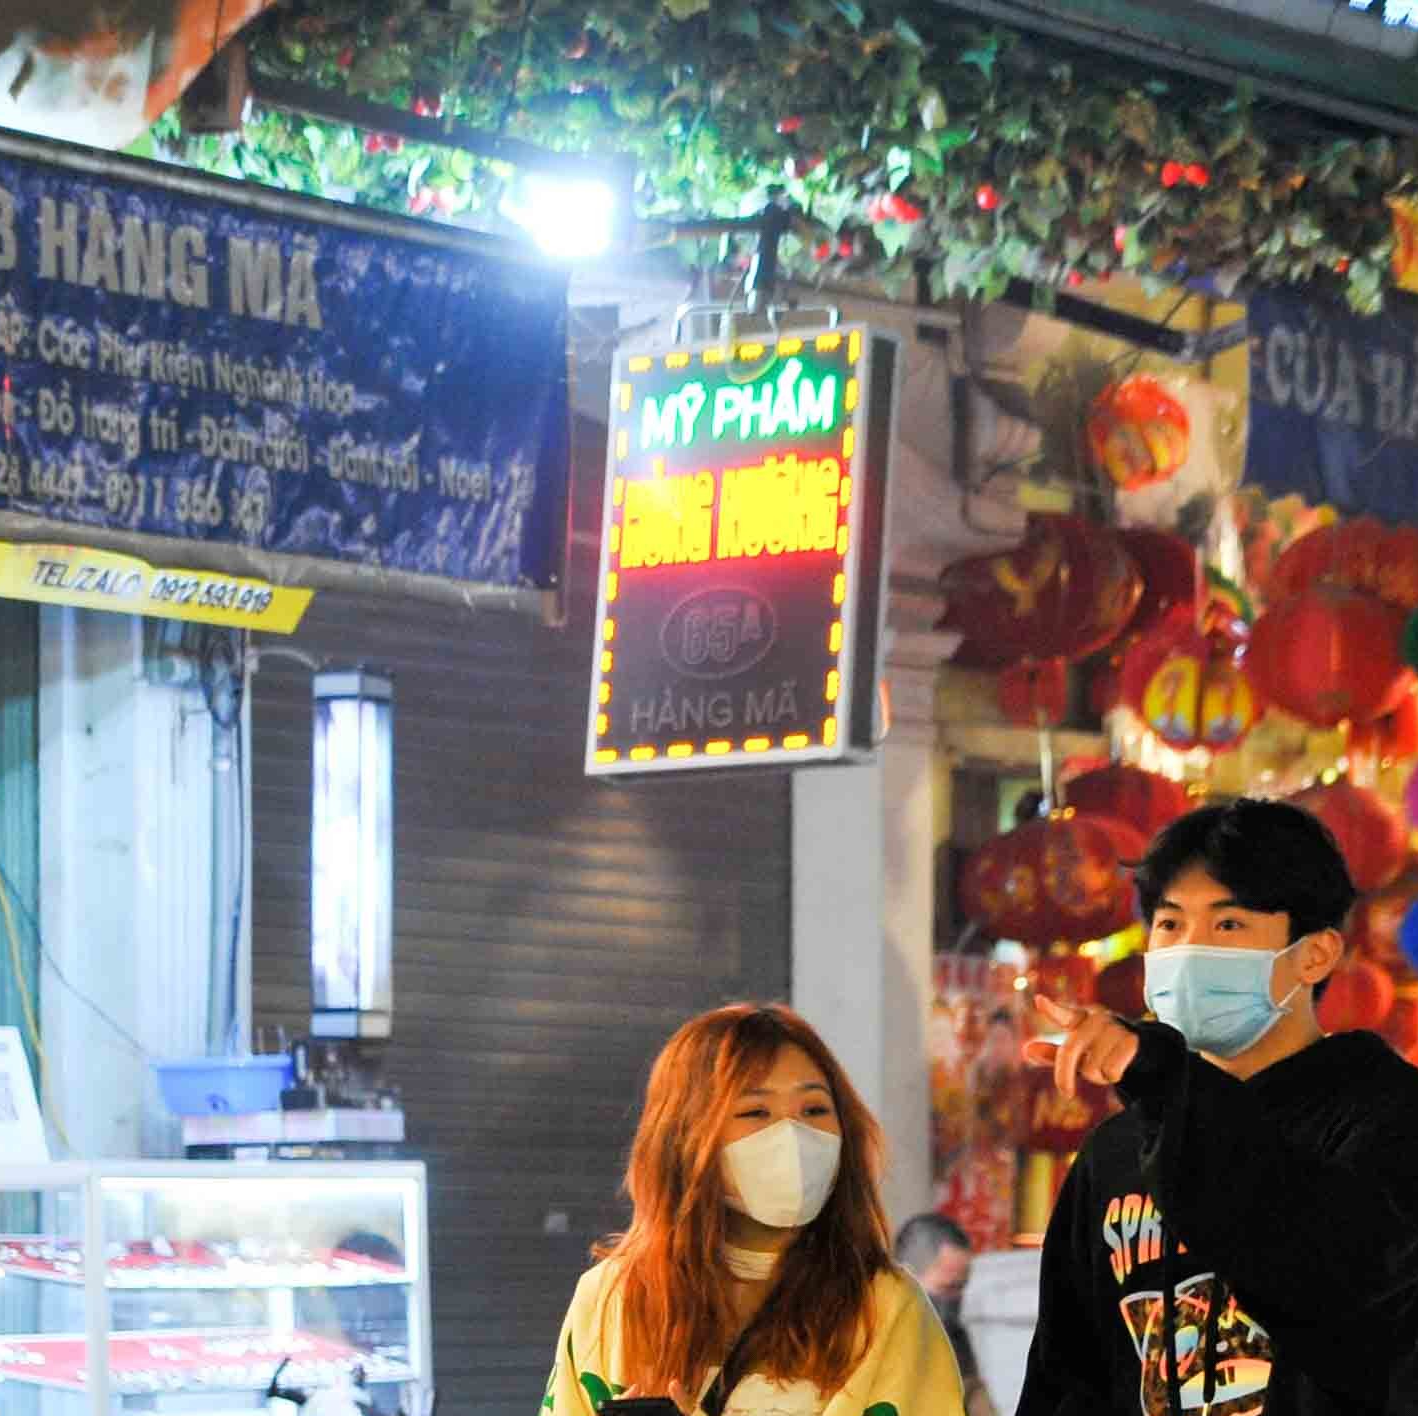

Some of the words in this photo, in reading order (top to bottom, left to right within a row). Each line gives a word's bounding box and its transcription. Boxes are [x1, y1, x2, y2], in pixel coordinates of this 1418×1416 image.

[38, 192, 210, 308] HÀNG
[228, 234, 324, 330] MÃ
[682, 597, 763, 666] 65A
[630, 684, 732, 735] HÀNG
[744, 680, 799, 726] MÃ
